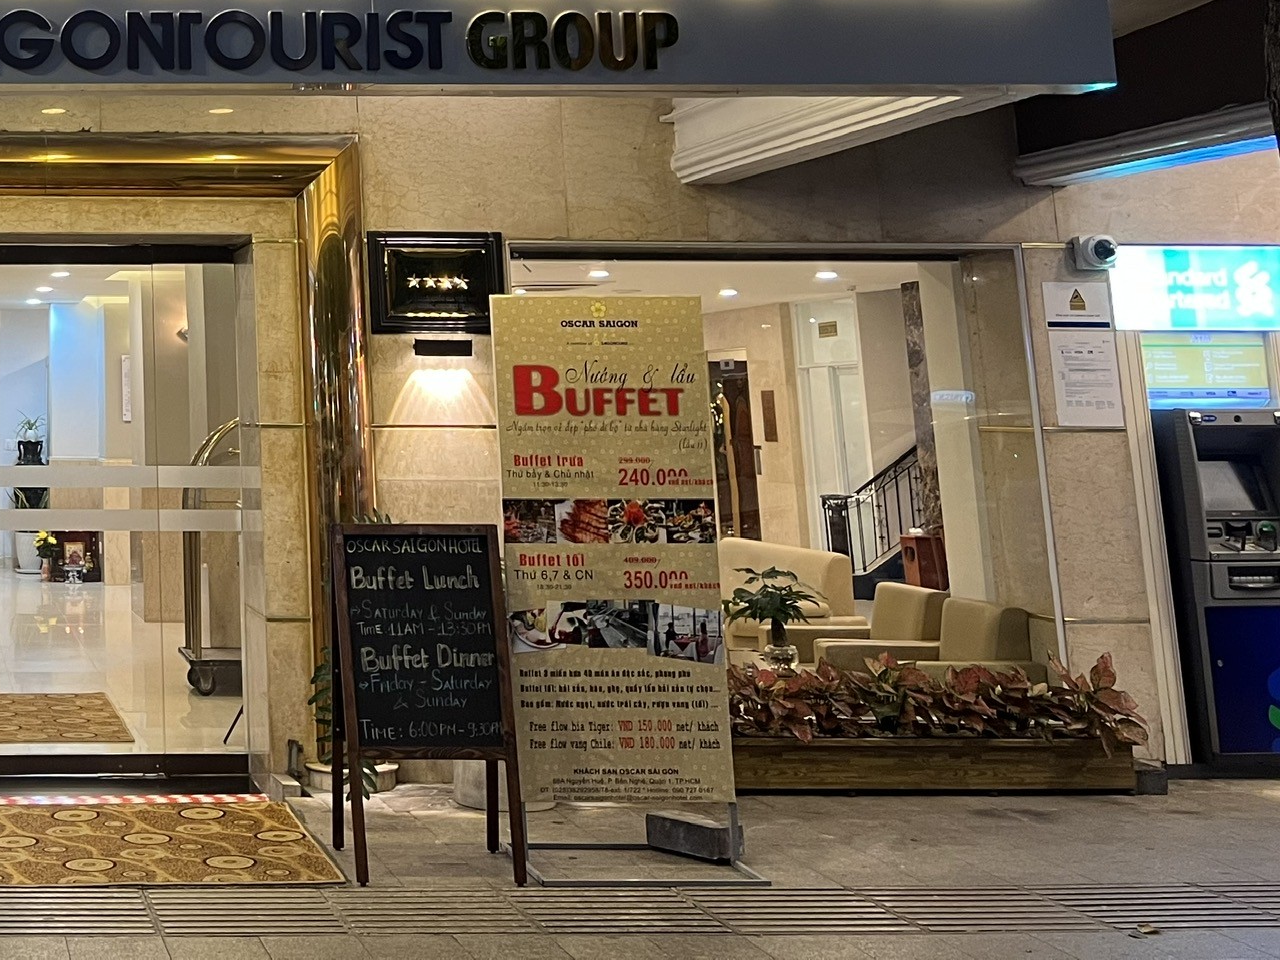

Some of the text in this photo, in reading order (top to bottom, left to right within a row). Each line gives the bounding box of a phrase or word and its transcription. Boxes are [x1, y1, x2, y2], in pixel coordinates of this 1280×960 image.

[465, 10, 680, 71] GROUP
[560, 320, 638, 328] OSCAR SAIGON
[565, 359, 628, 392] Nướng
[642, 364, 659, 393] &
[512, 364, 685, 417] BUFFET
[513, 454, 552, 467] Buffet
[556, 454, 584, 467] trưa
[506, 469, 523, 478] Thứ
[544, 469, 551, 478] &
[553, 468, 571, 478] Chủ
[574, 469, 594, 479] nhật
[346, 538, 391, 554] OSCAR
[392, 537, 447, 554] SAIGON
[519, 553, 561, 567] Buffet
[350, 564, 480, 590] Buffet Lunch
[513, 569, 593, 581] Thứ 6,7 & CN
[360, 643, 495, 672] Buffet Dinner
[529, 721, 547, 732] Free
[551, 720, 568, 732] flow
[571, 720, 585, 732] bia
[588, 721, 614, 734] Tiger:
[638, 719, 672, 732] 150.000
[529, 738, 547, 749] Free
[550, 738, 567, 749] flow
[570, 740, 587, 751] vang
[639, 736, 675, 749] 180.000
